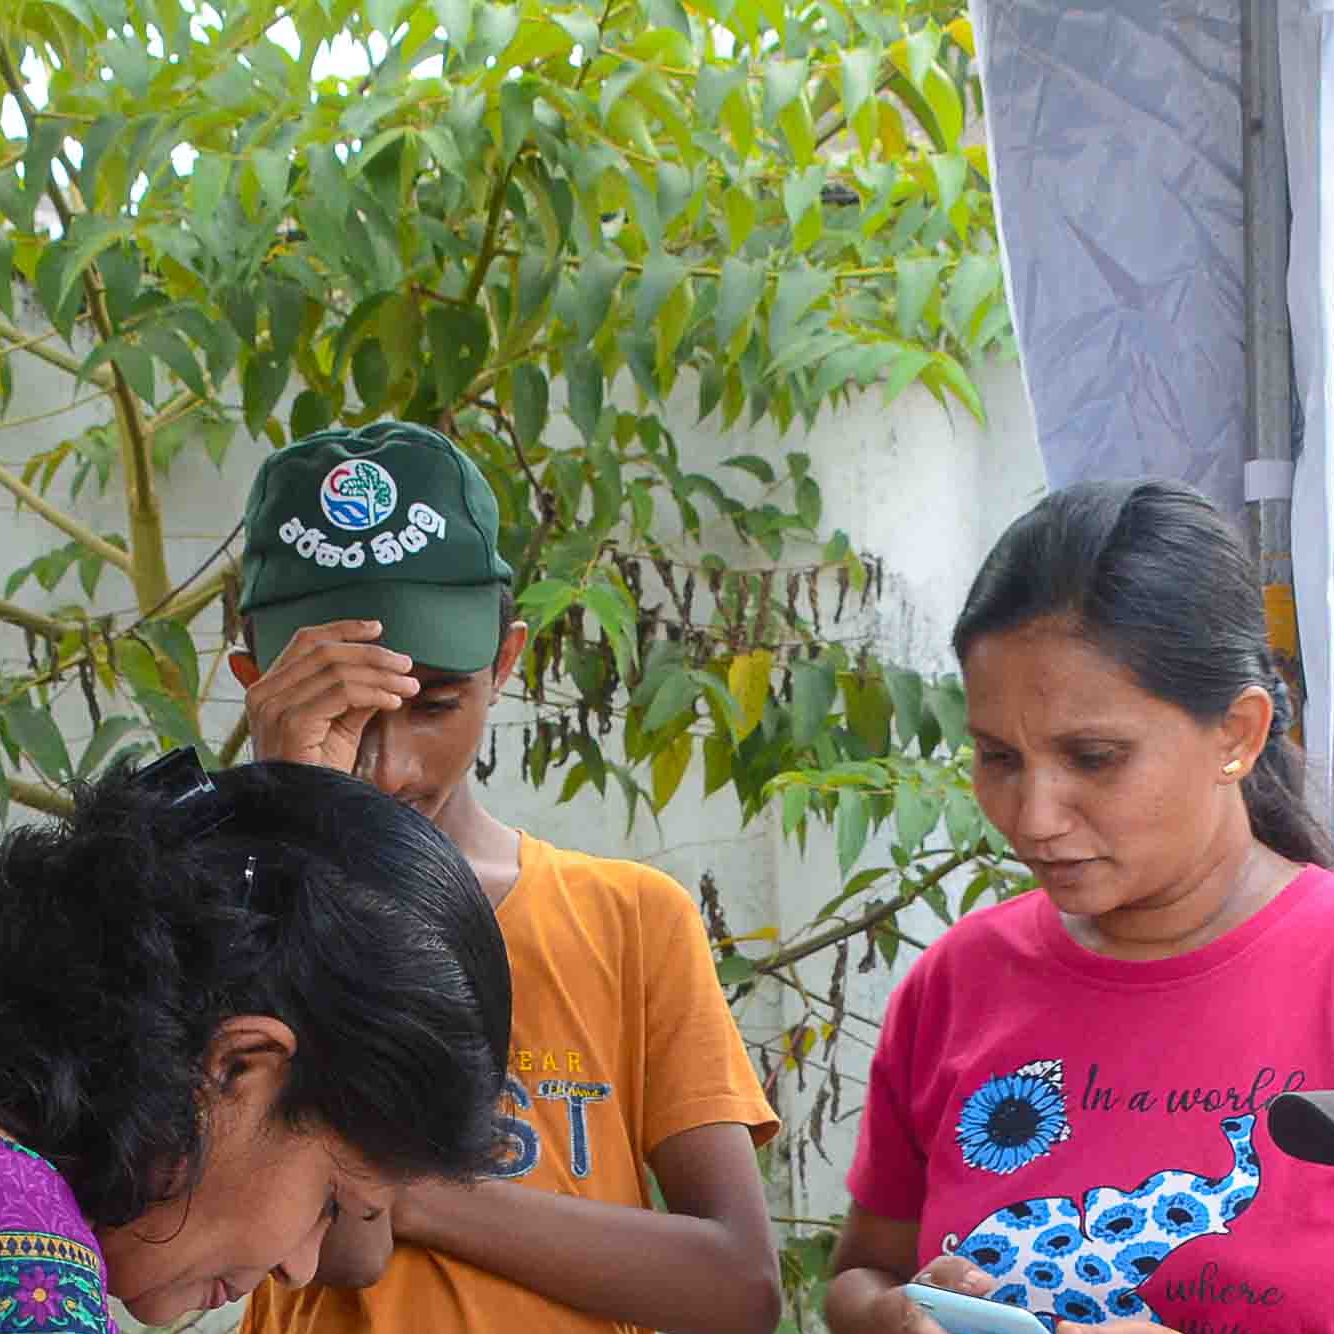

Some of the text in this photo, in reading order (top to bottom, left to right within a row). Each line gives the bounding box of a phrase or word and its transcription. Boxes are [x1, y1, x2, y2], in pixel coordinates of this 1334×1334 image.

[1081, 1063, 1119, 1111] In
[1129, 1087, 1158, 1113] a
[1166, 1262, 1286, 1306] where
